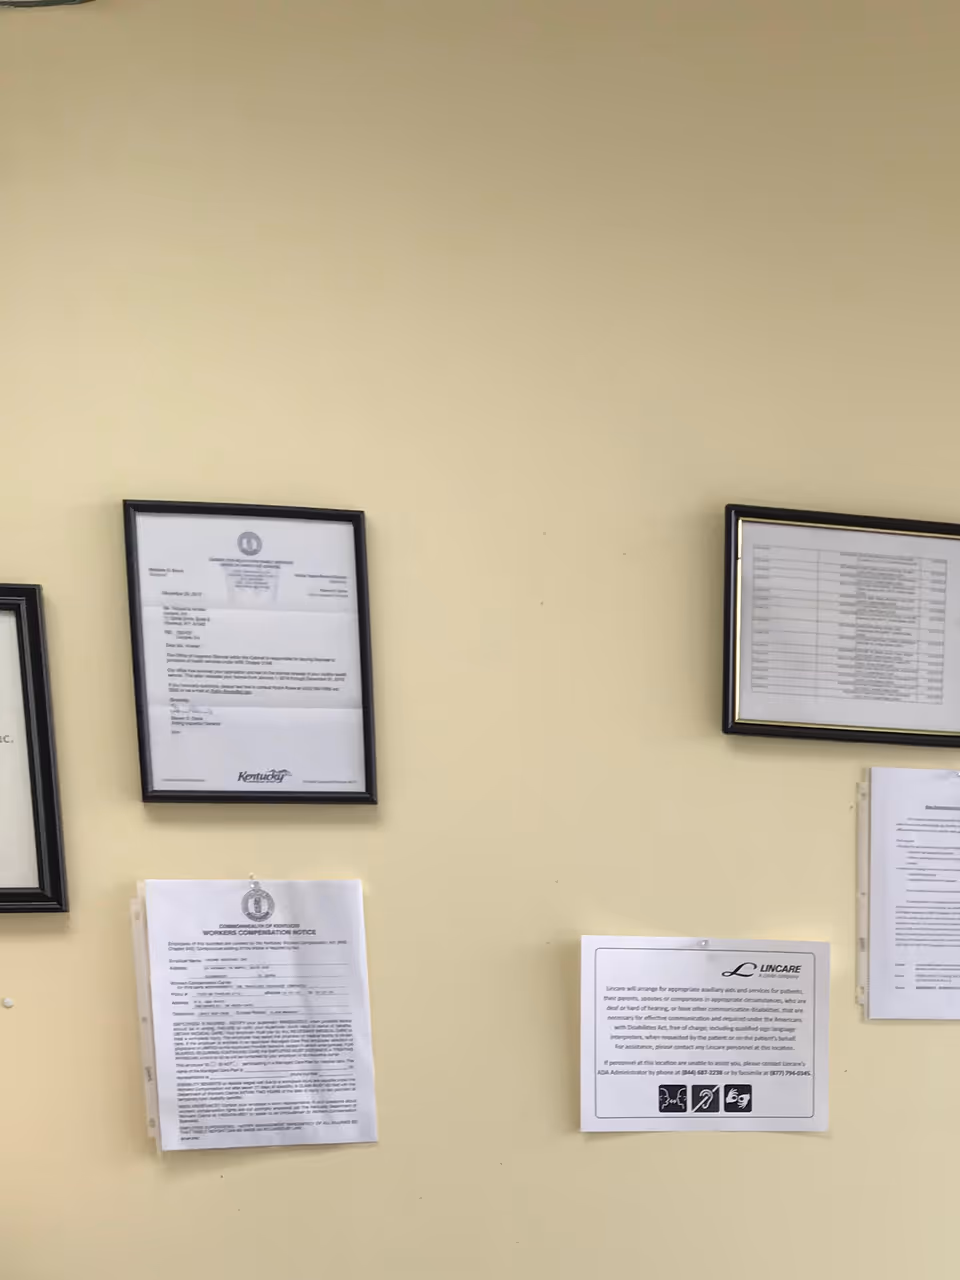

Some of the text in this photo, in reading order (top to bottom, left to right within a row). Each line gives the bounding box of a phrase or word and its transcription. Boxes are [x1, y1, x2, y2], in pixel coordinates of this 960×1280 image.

[0, 735, 14, 743] C.
[237, 770, 286, 784] Kentucky
[760, 964, 803, 973] LINCARE
